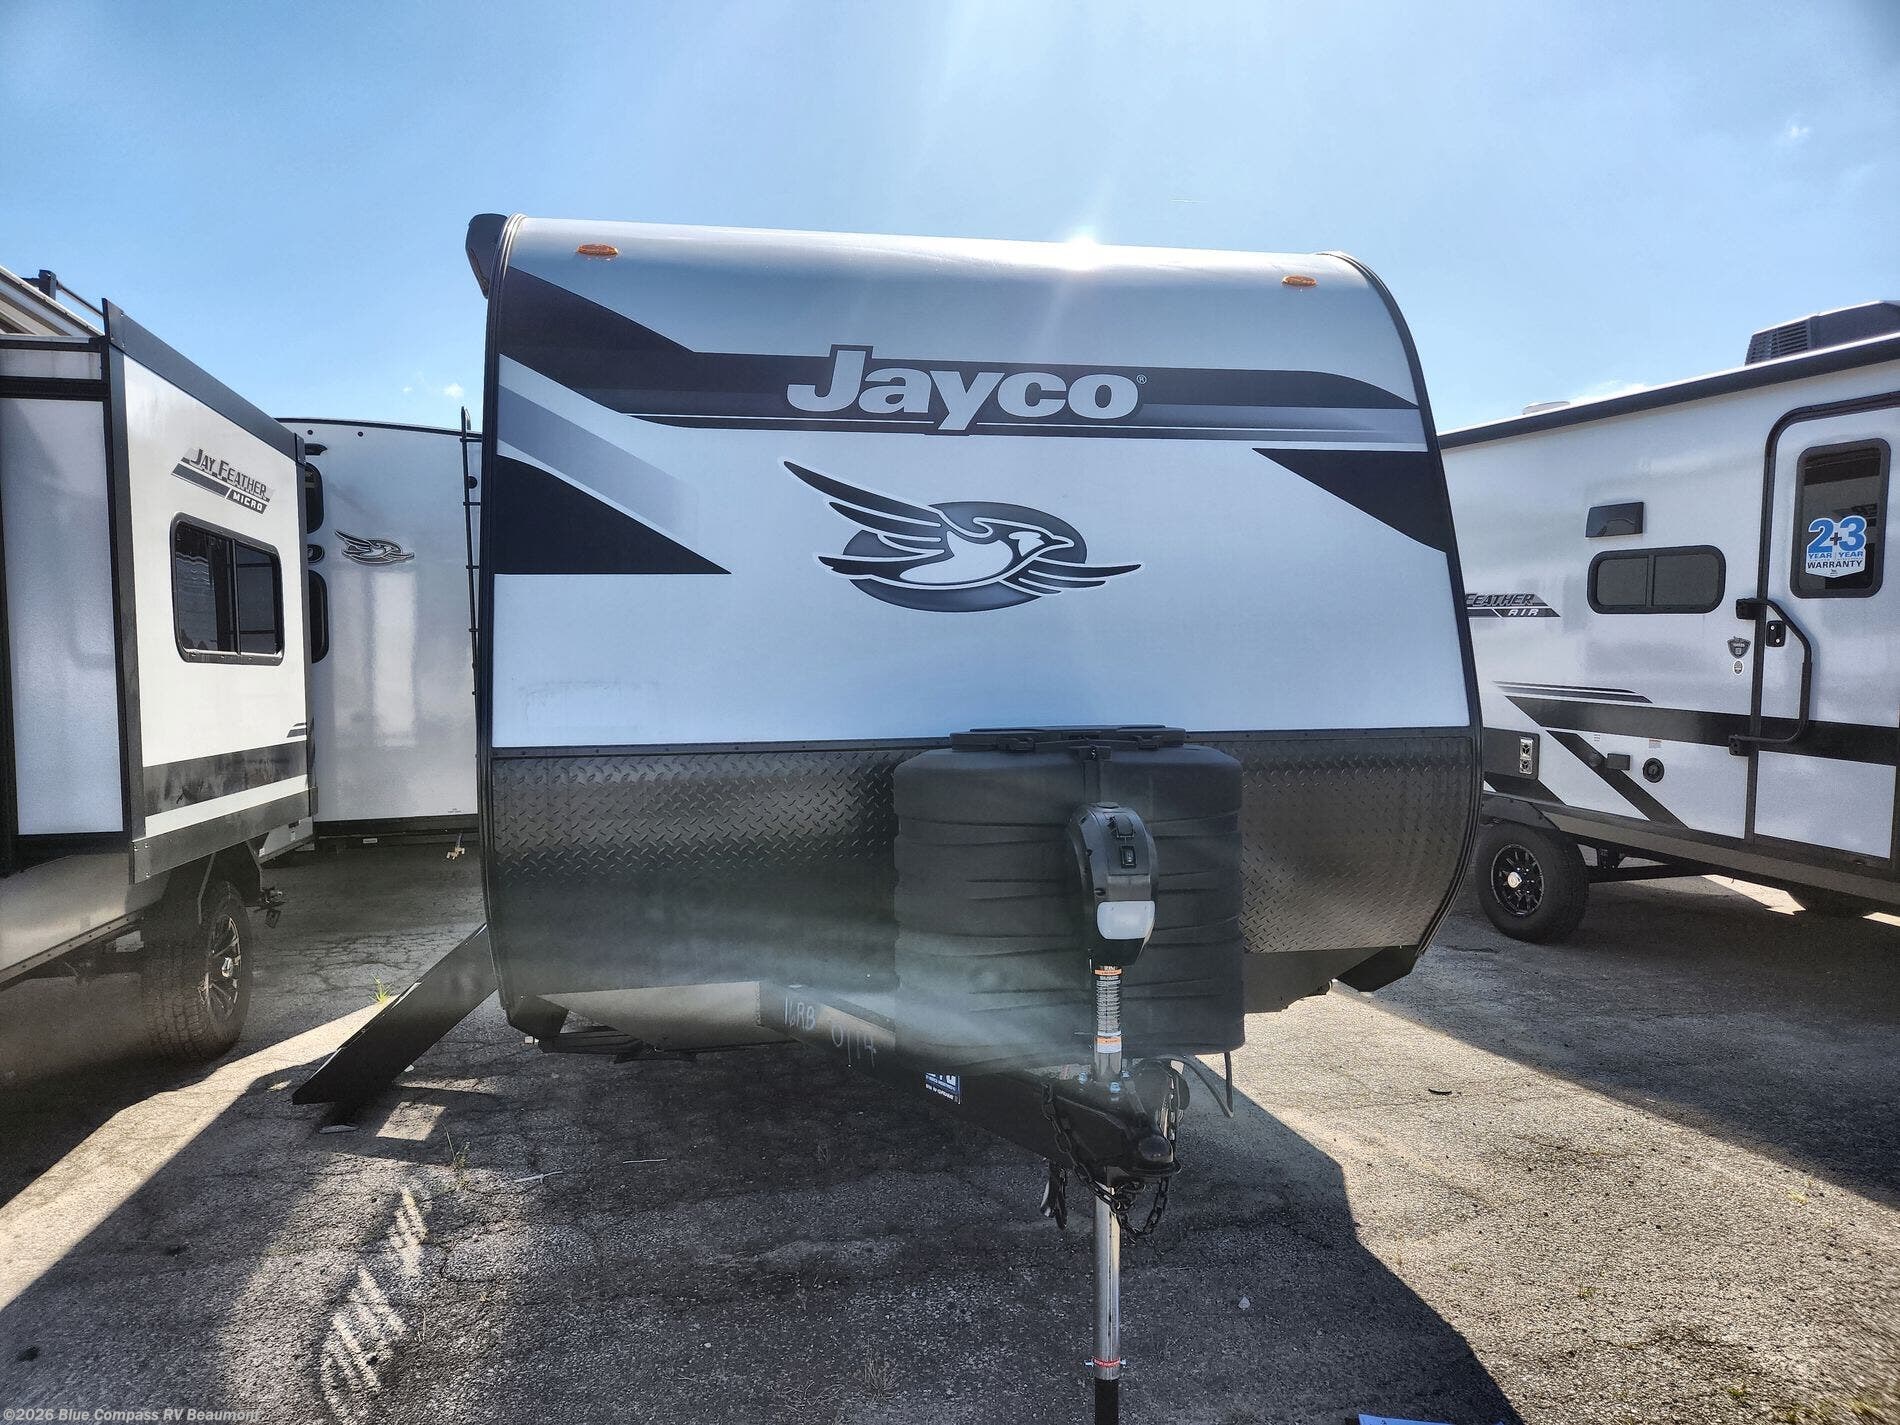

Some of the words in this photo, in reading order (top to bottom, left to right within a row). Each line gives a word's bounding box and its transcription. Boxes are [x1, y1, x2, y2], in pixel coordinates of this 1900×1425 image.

[218, 459, 269, 500] FEATHER
[232, 491, 264, 512] MICRO
[1808, 552, 1833, 560] YEAR
[1838, 550, 1864, 558] YEAR
[1807, 559, 1863, 569] WARRANTY
[1507, 608, 1539, 616] AIR
